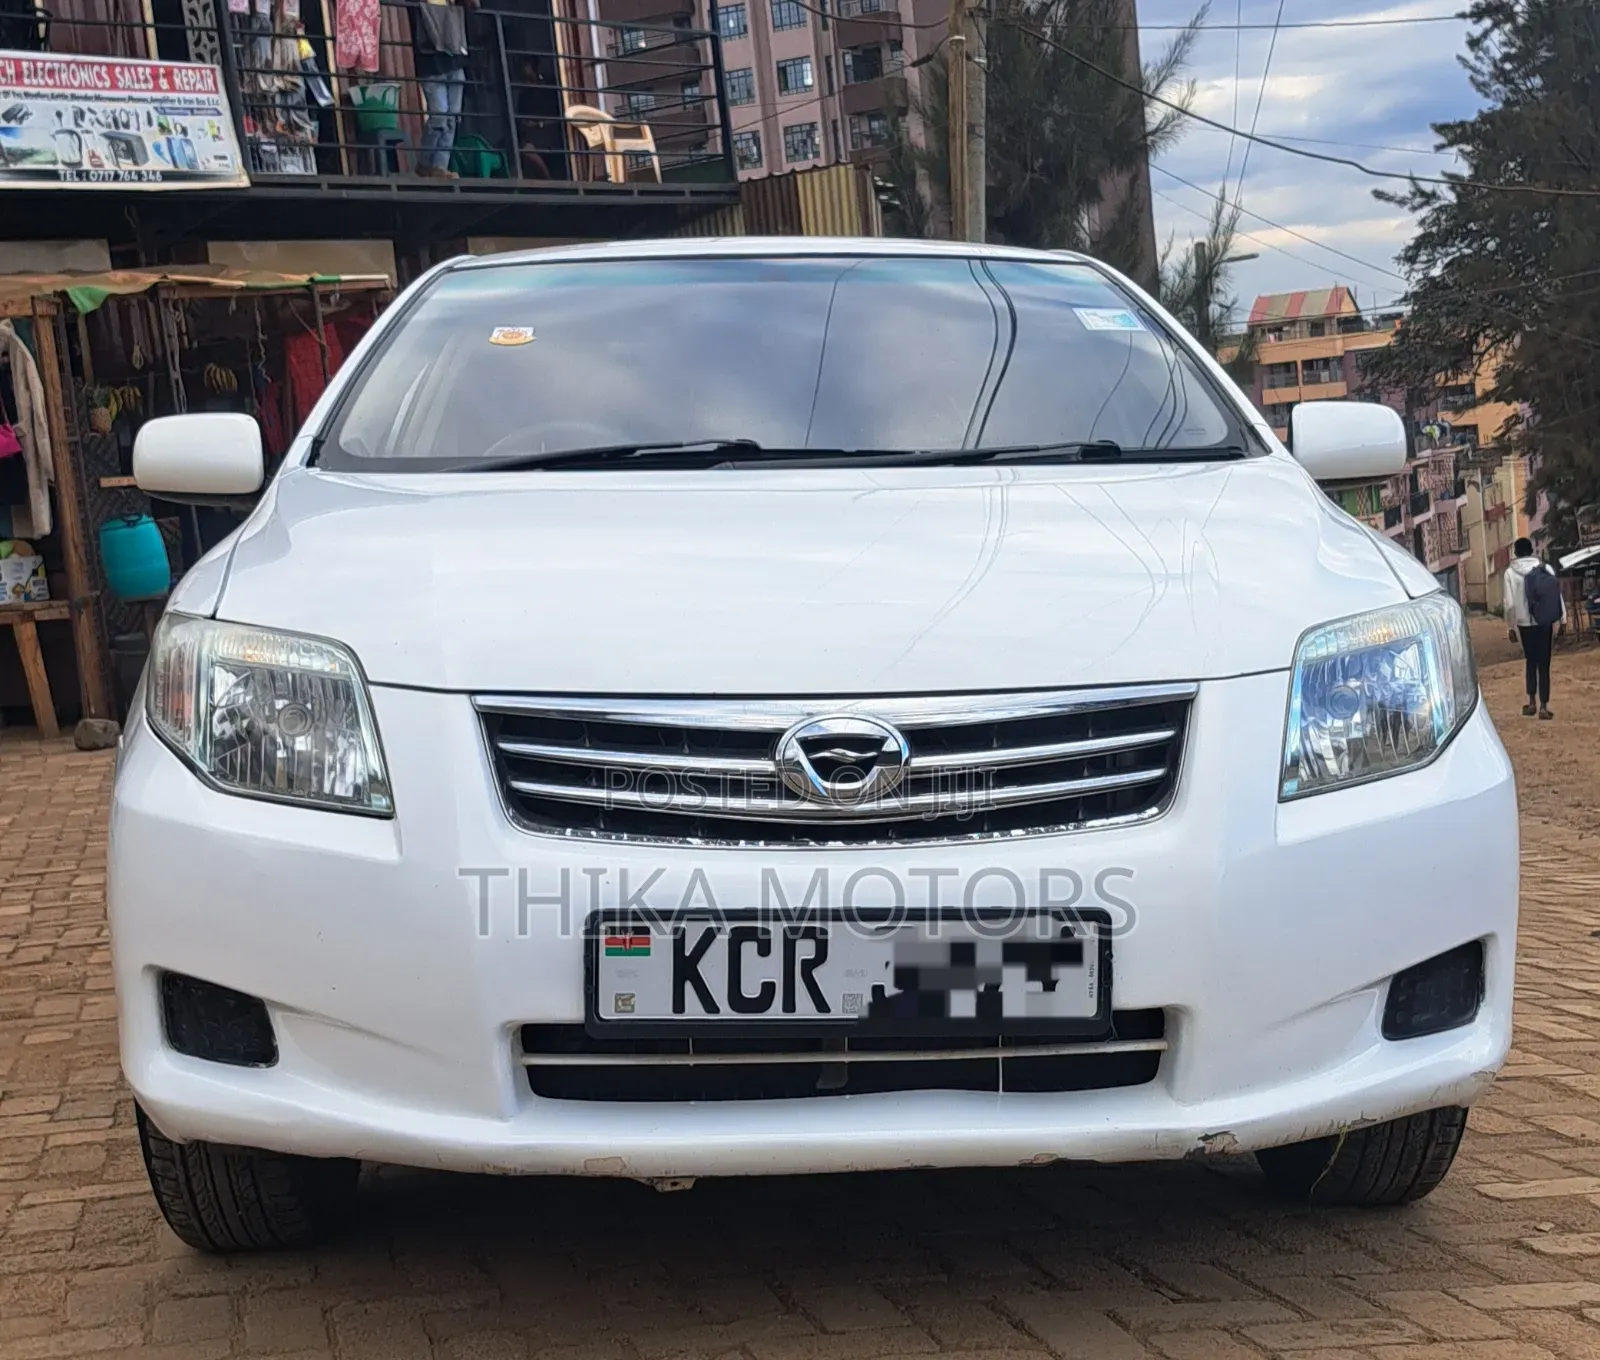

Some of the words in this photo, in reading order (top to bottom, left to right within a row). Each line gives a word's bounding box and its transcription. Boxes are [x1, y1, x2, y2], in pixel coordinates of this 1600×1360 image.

[21, 61, 111, 88] ELECTRONICS
[114, 66, 153, 90] SALES
[159, 67, 170, 90] &
[173, 68, 216, 92] REPAIR
[89, 170, 114, 182] 0717
[118, 170, 139, 182] 764
[141, 170, 163, 182] 346
[671, 925, 832, 1015] KCR
